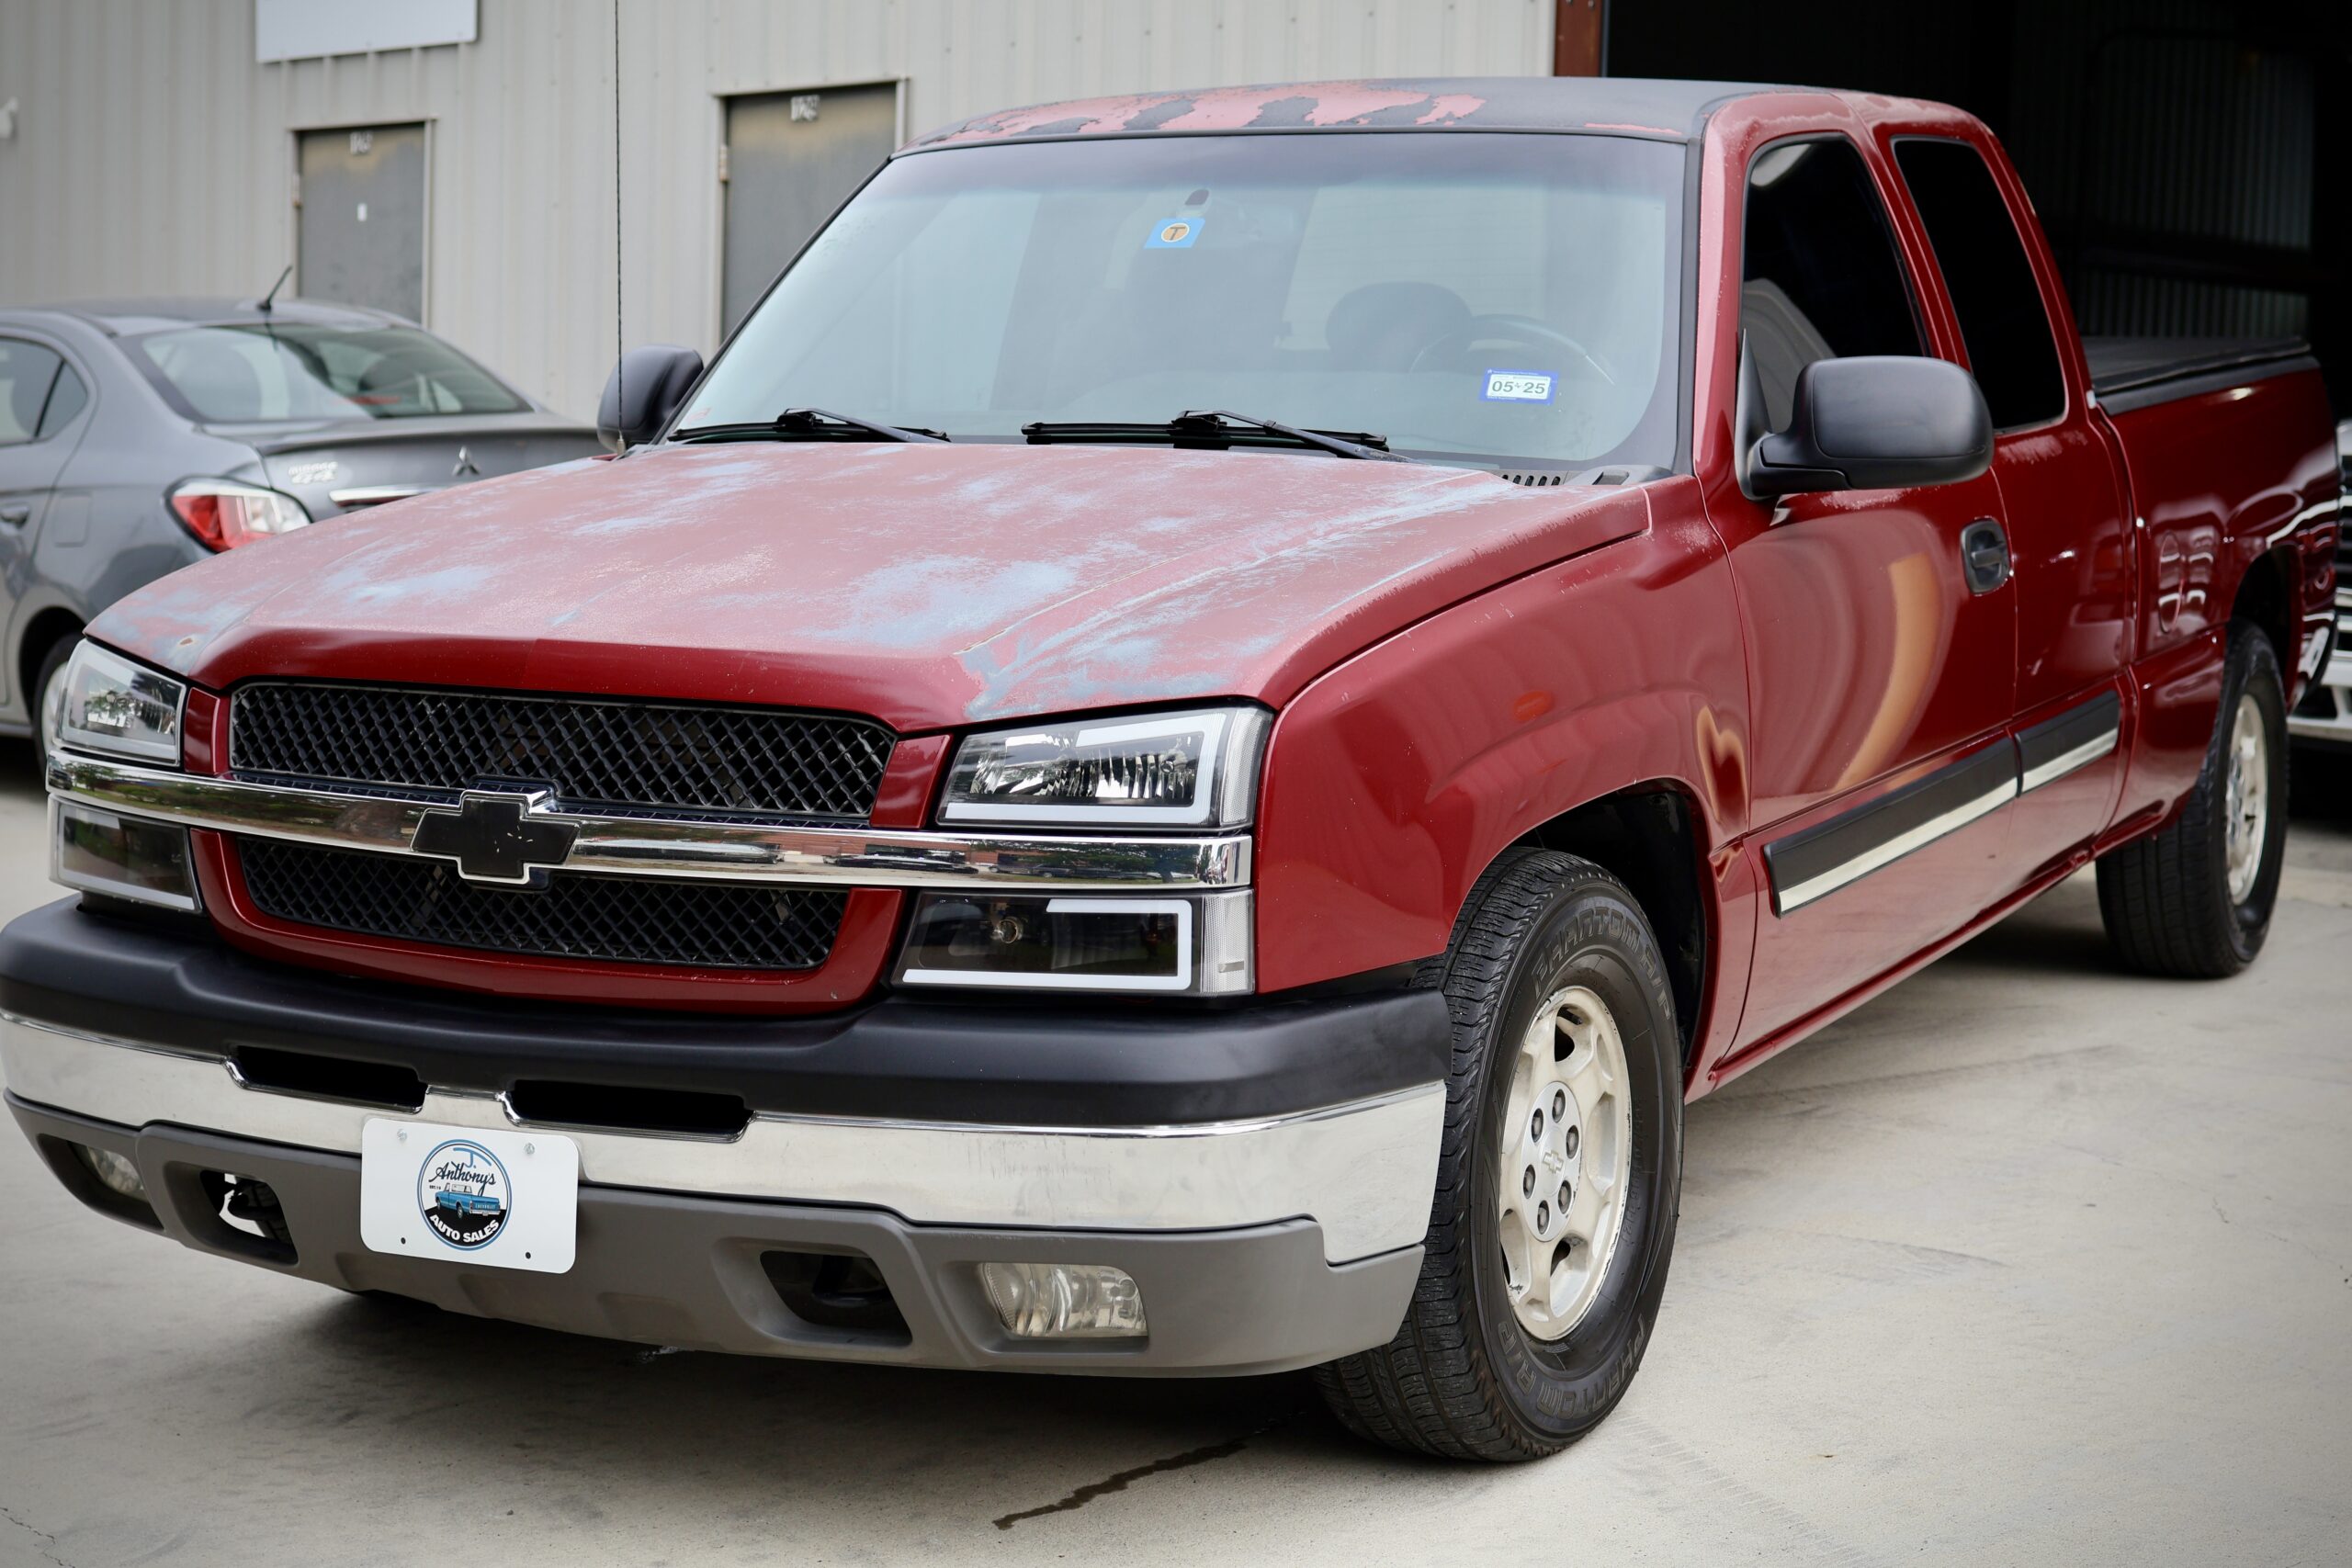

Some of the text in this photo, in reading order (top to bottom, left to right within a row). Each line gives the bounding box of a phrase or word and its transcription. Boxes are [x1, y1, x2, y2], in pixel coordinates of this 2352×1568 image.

[1532, 906, 1641, 1000] PHANTOM
[428, 1160, 496, 1197] Anthony's
[429, 1213, 500, 1243] AUTO SALES
